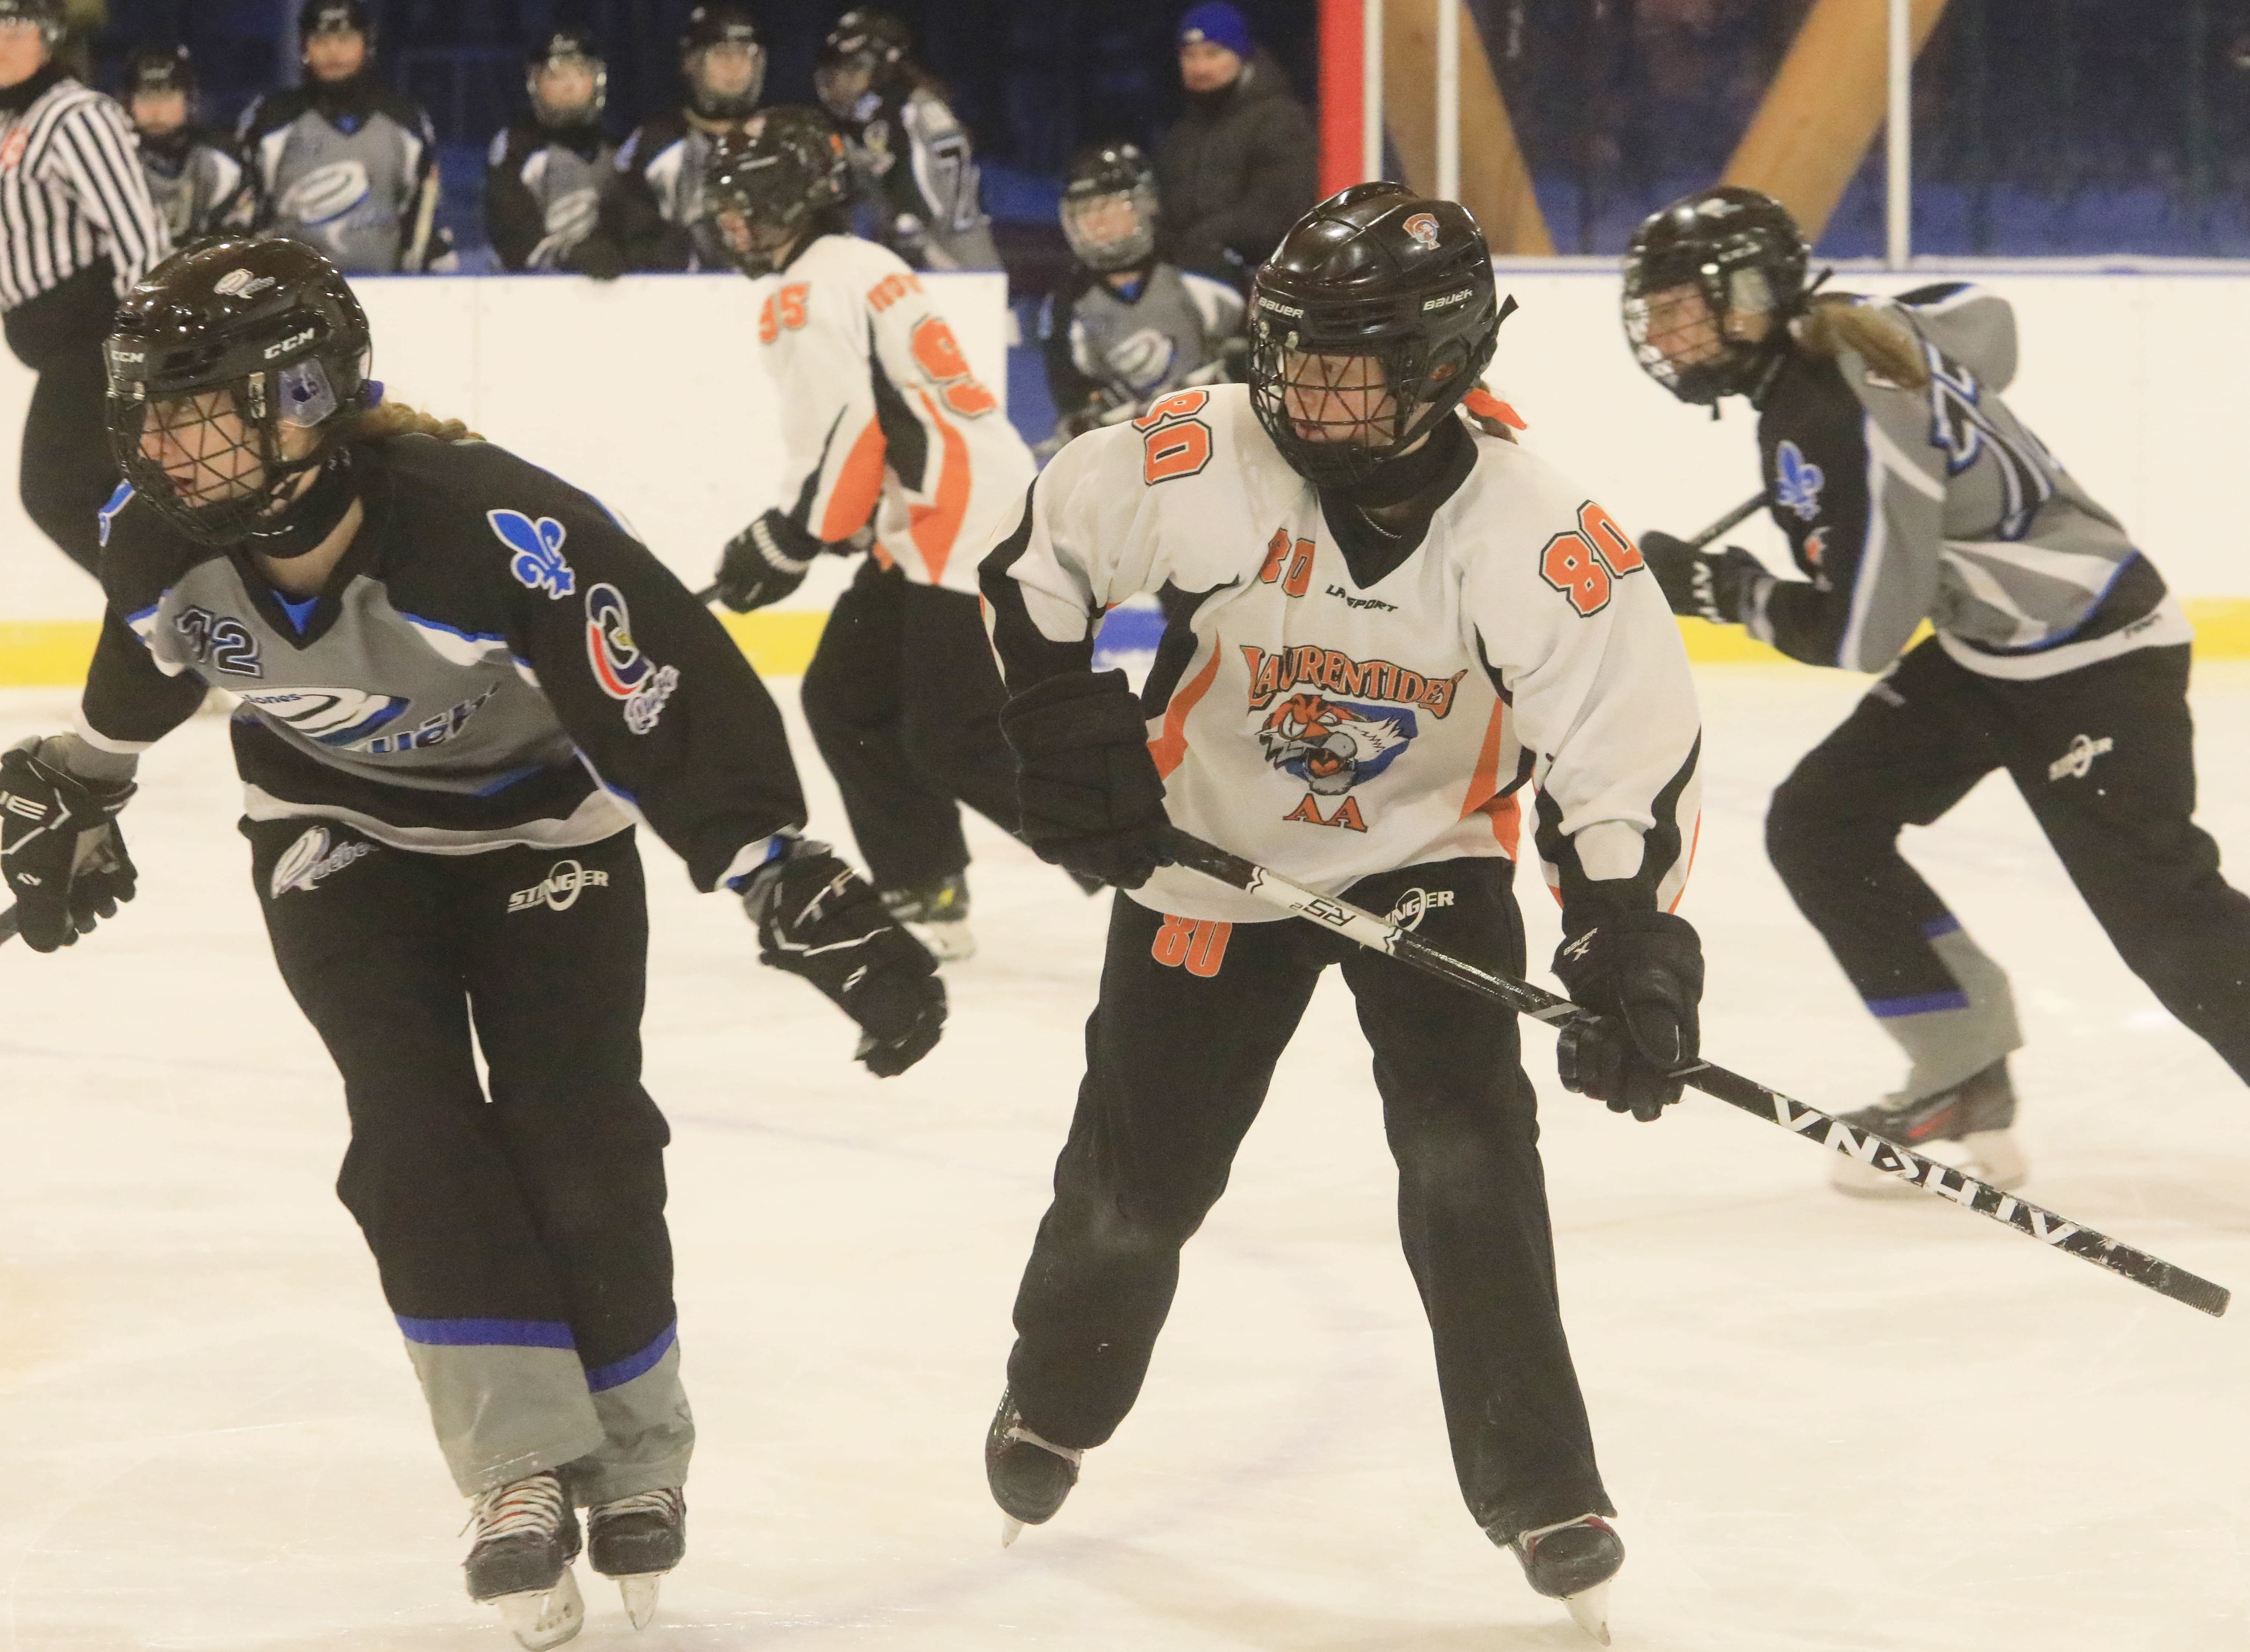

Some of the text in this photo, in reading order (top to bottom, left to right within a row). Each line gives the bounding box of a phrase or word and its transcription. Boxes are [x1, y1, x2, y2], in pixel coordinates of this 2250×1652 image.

[1258, 296, 1304, 319] BAUER
[1422, 288, 1473, 311] BAUER
[111, 350, 144, 363] CCM
[264, 327, 314, 360] CCM
[1259, 528, 1316, 598] 80
[1539, 499, 1644, 618] 80
[1239, 644, 1469, 719] LAURENTIDES
[1282, 792, 1367, 833] AA
[507, 860, 610, 914] STINGER
[1382, 888, 1455, 931] INGER
[1151, 913, 1232, 978] 80
[1563, 927, 1598, 956] BAUER
